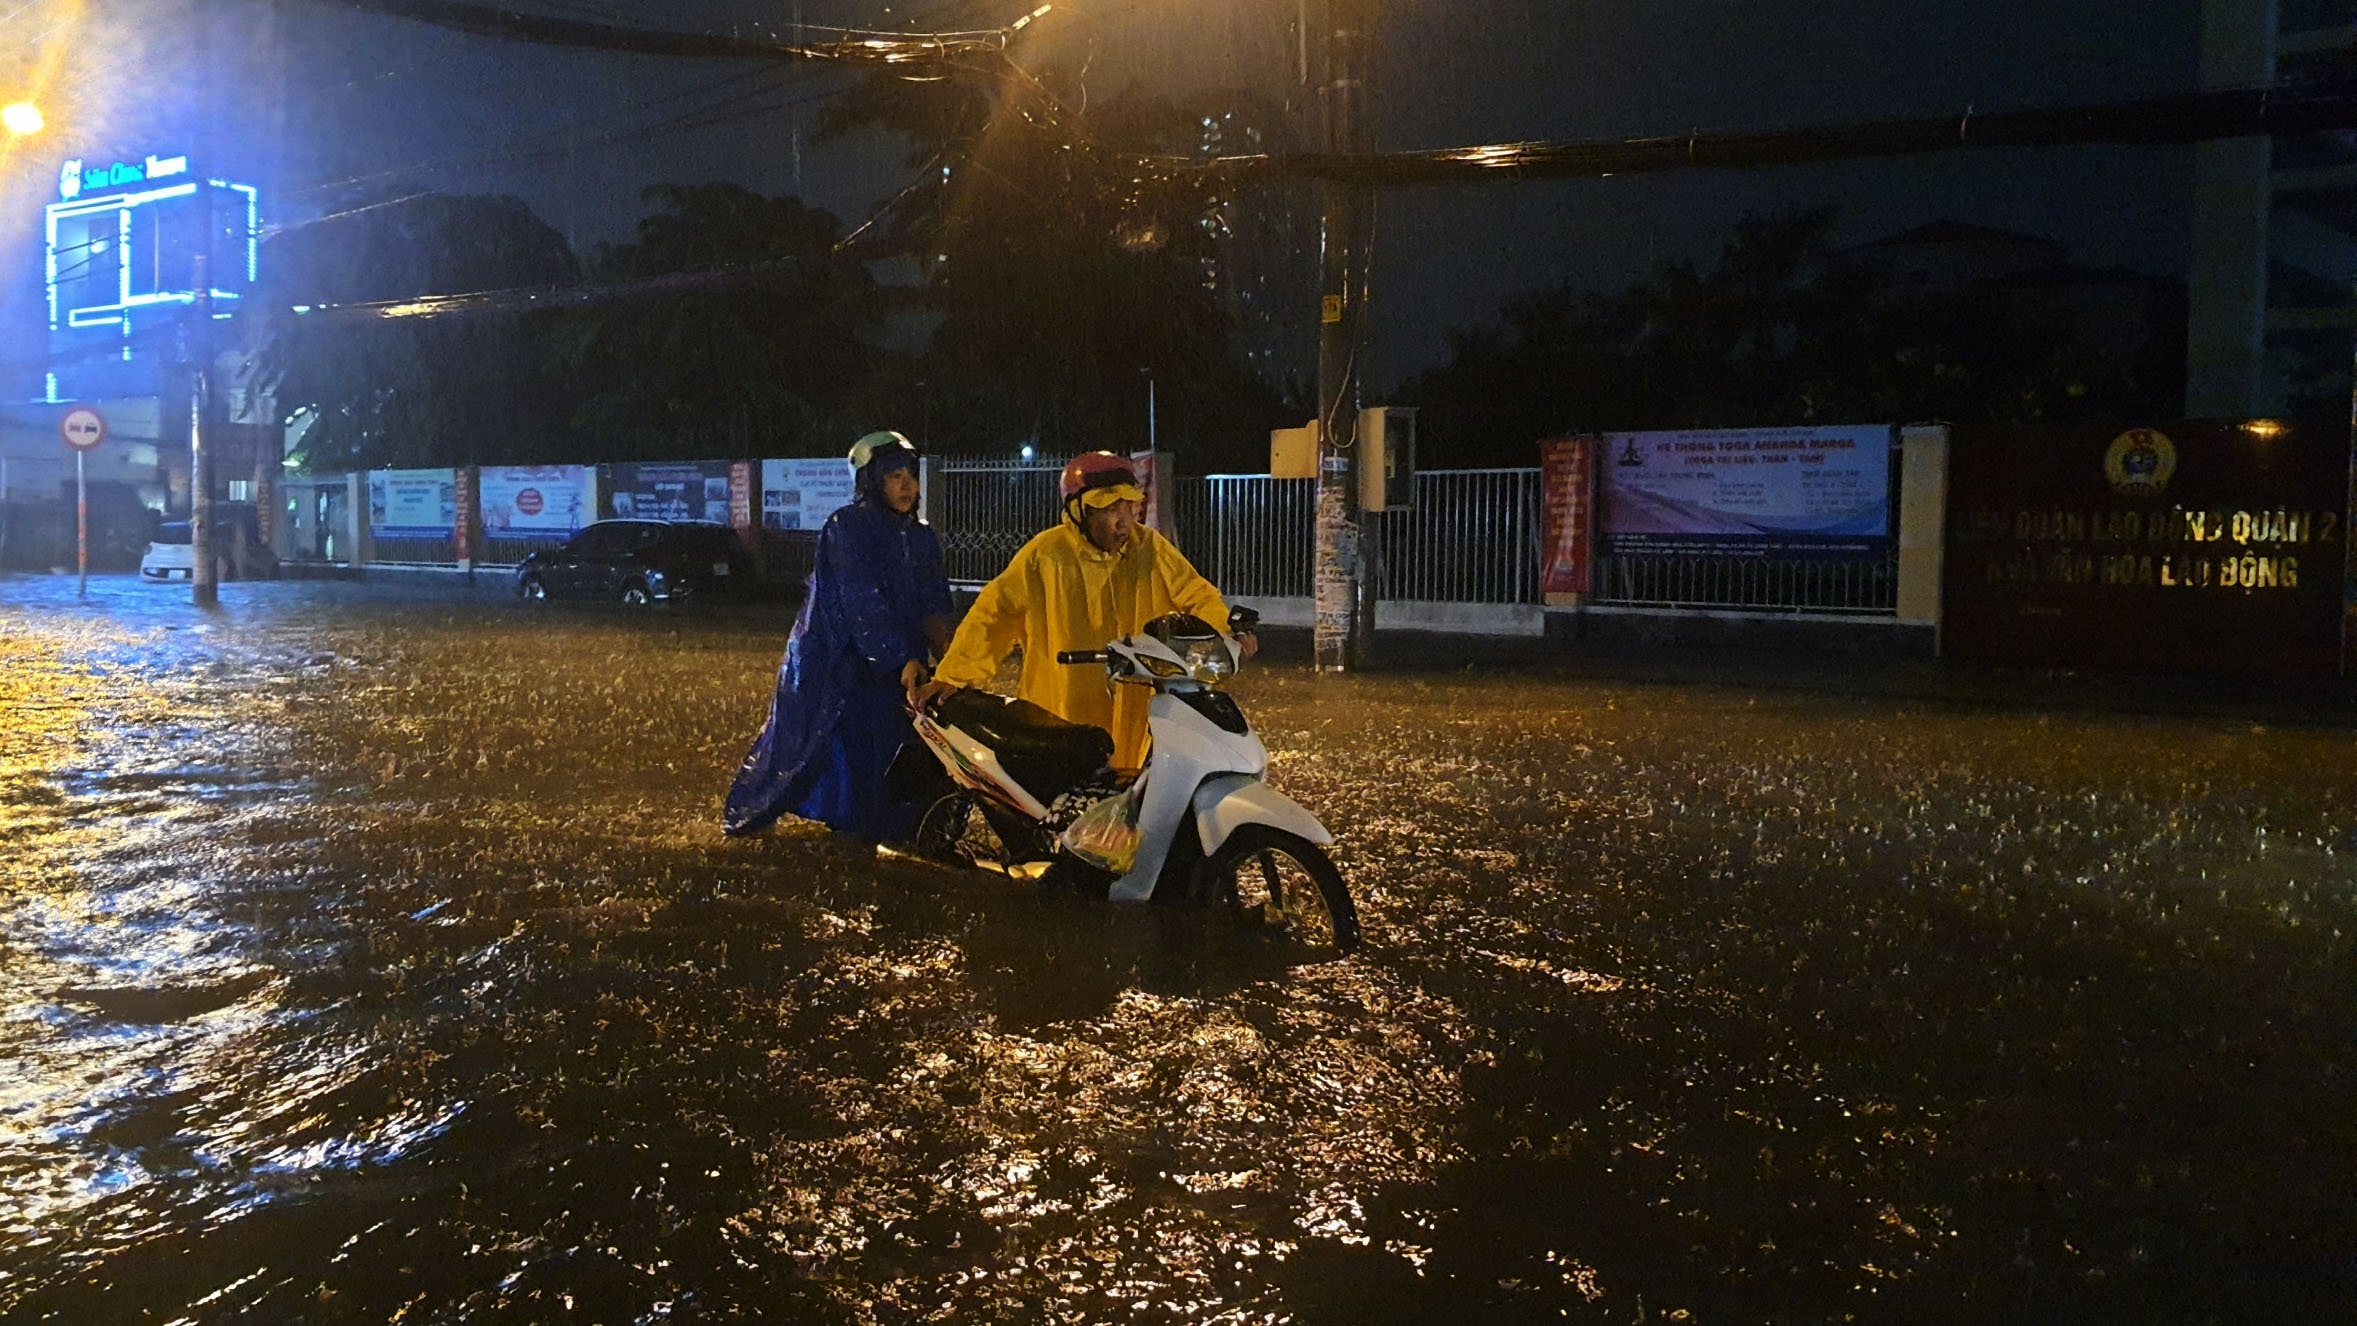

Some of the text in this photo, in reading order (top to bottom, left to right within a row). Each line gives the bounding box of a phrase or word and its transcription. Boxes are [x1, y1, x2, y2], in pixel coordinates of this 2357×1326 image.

[1719, 441, 1750, 452] YOGA
[2232, 504, 2310, 549] QUẬN
[2318, 511, 2337, 542] 2
[2219, 549, 2298, 595] ĐỘNG
